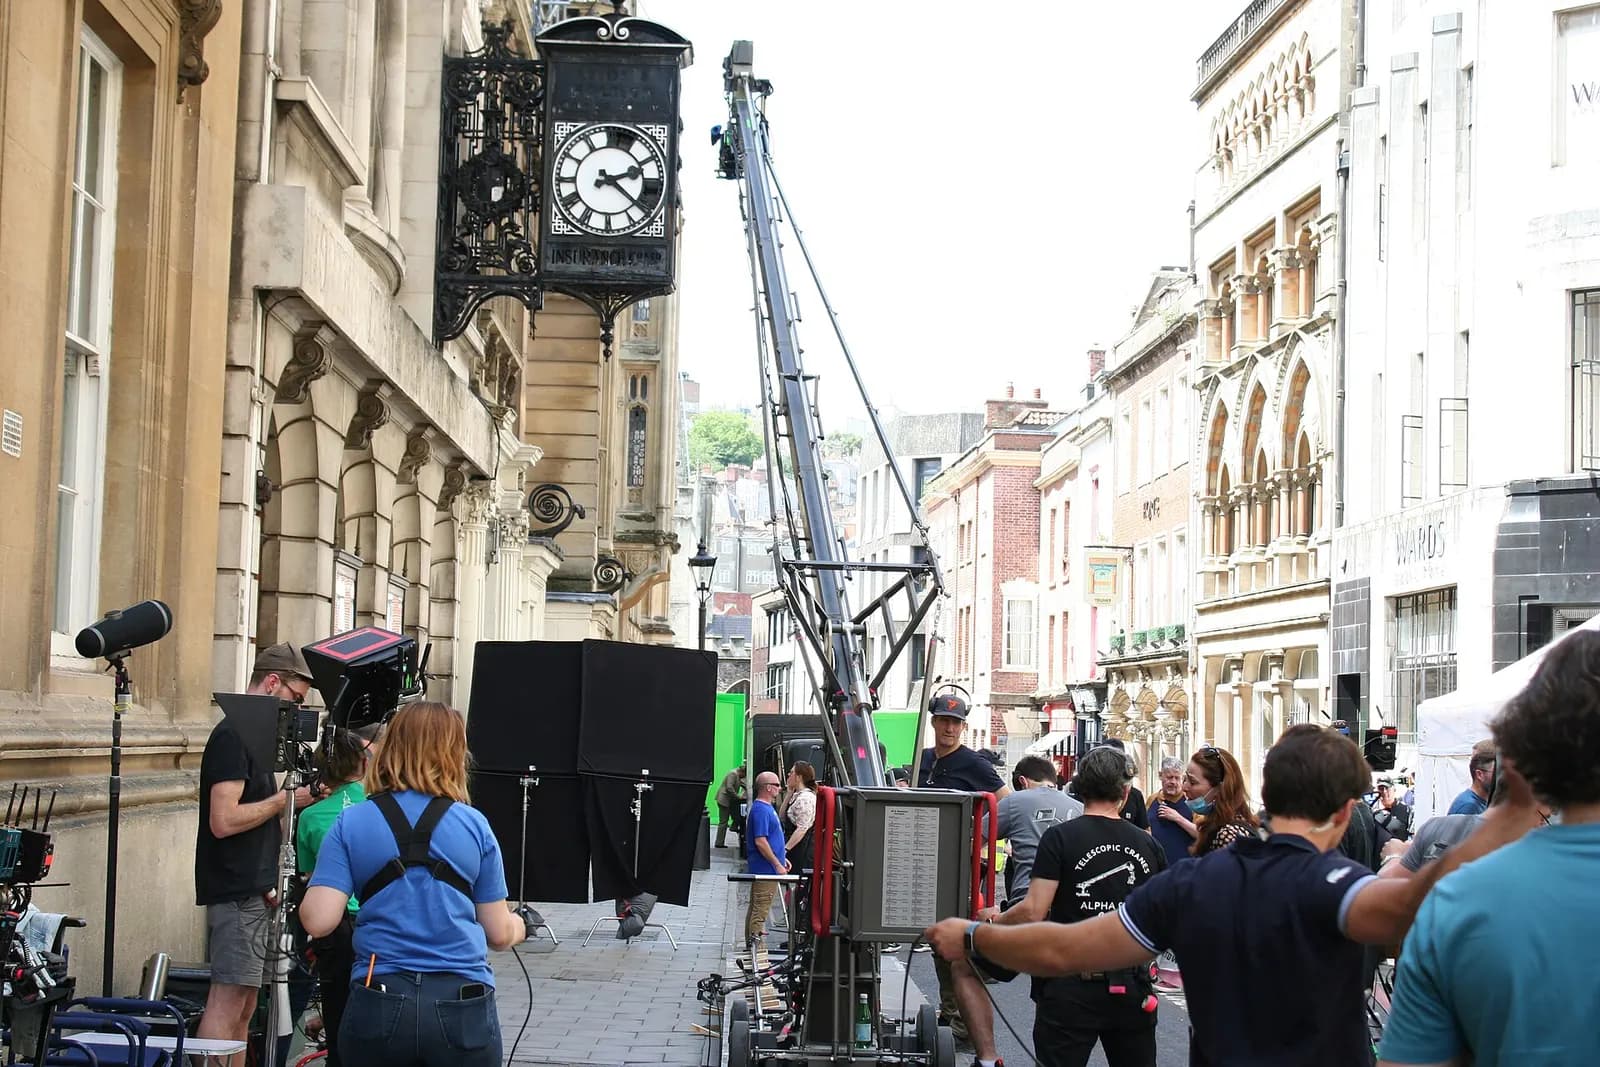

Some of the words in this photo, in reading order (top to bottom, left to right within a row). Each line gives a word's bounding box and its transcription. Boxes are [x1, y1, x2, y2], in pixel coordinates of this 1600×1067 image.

[1396, 521, 1445, 566] WARDS
[1074, 844, 1120, 871] TELESCOPIC
[1124, 847, 1150, 874] CRANES
[1080, 901, 1116, 911] ALPHA
